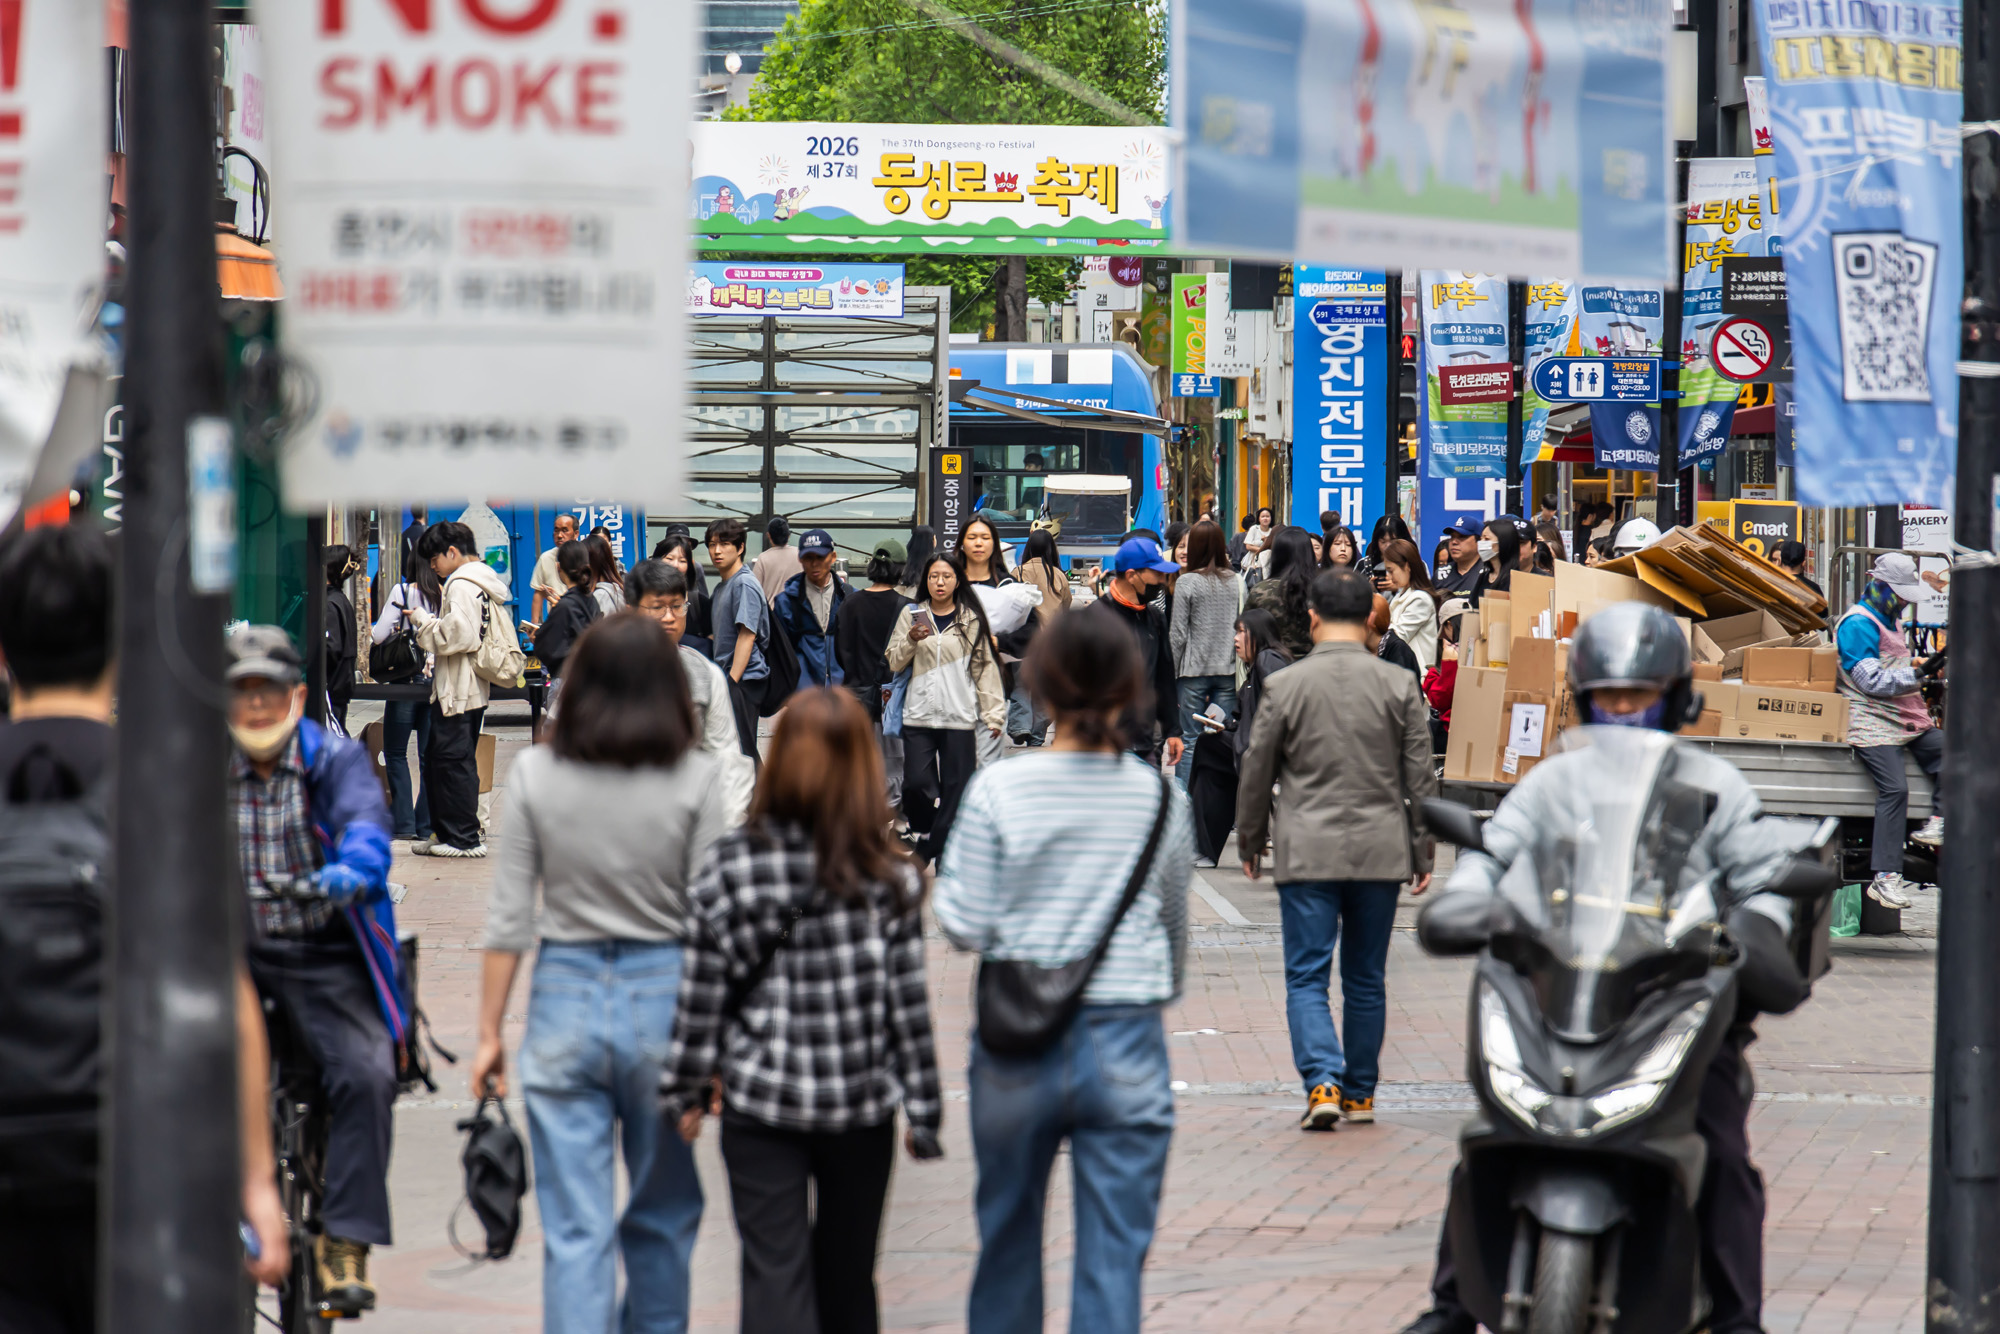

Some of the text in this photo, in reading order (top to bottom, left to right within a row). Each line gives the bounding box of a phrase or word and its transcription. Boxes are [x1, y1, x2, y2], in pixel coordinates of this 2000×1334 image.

[318, 57, 623, 134] SMOKE
[806, 136, 859, 156] 2026
[882, 138, 1035, 150] The 37th Dongseong-ro Festival
[872, 153, 1118, 220] 동성로 축제
[712, 284, 832, 307] 캐릭터 스트리트
[1315, 311, 1328, 319] 591
[1319, 325, 1366, 554] 영진전문대
[572, 504, 624, 532] 가정
[1742, 520, 1789, 537] emart
[1903, 515, 1949, 526] BAKERY
